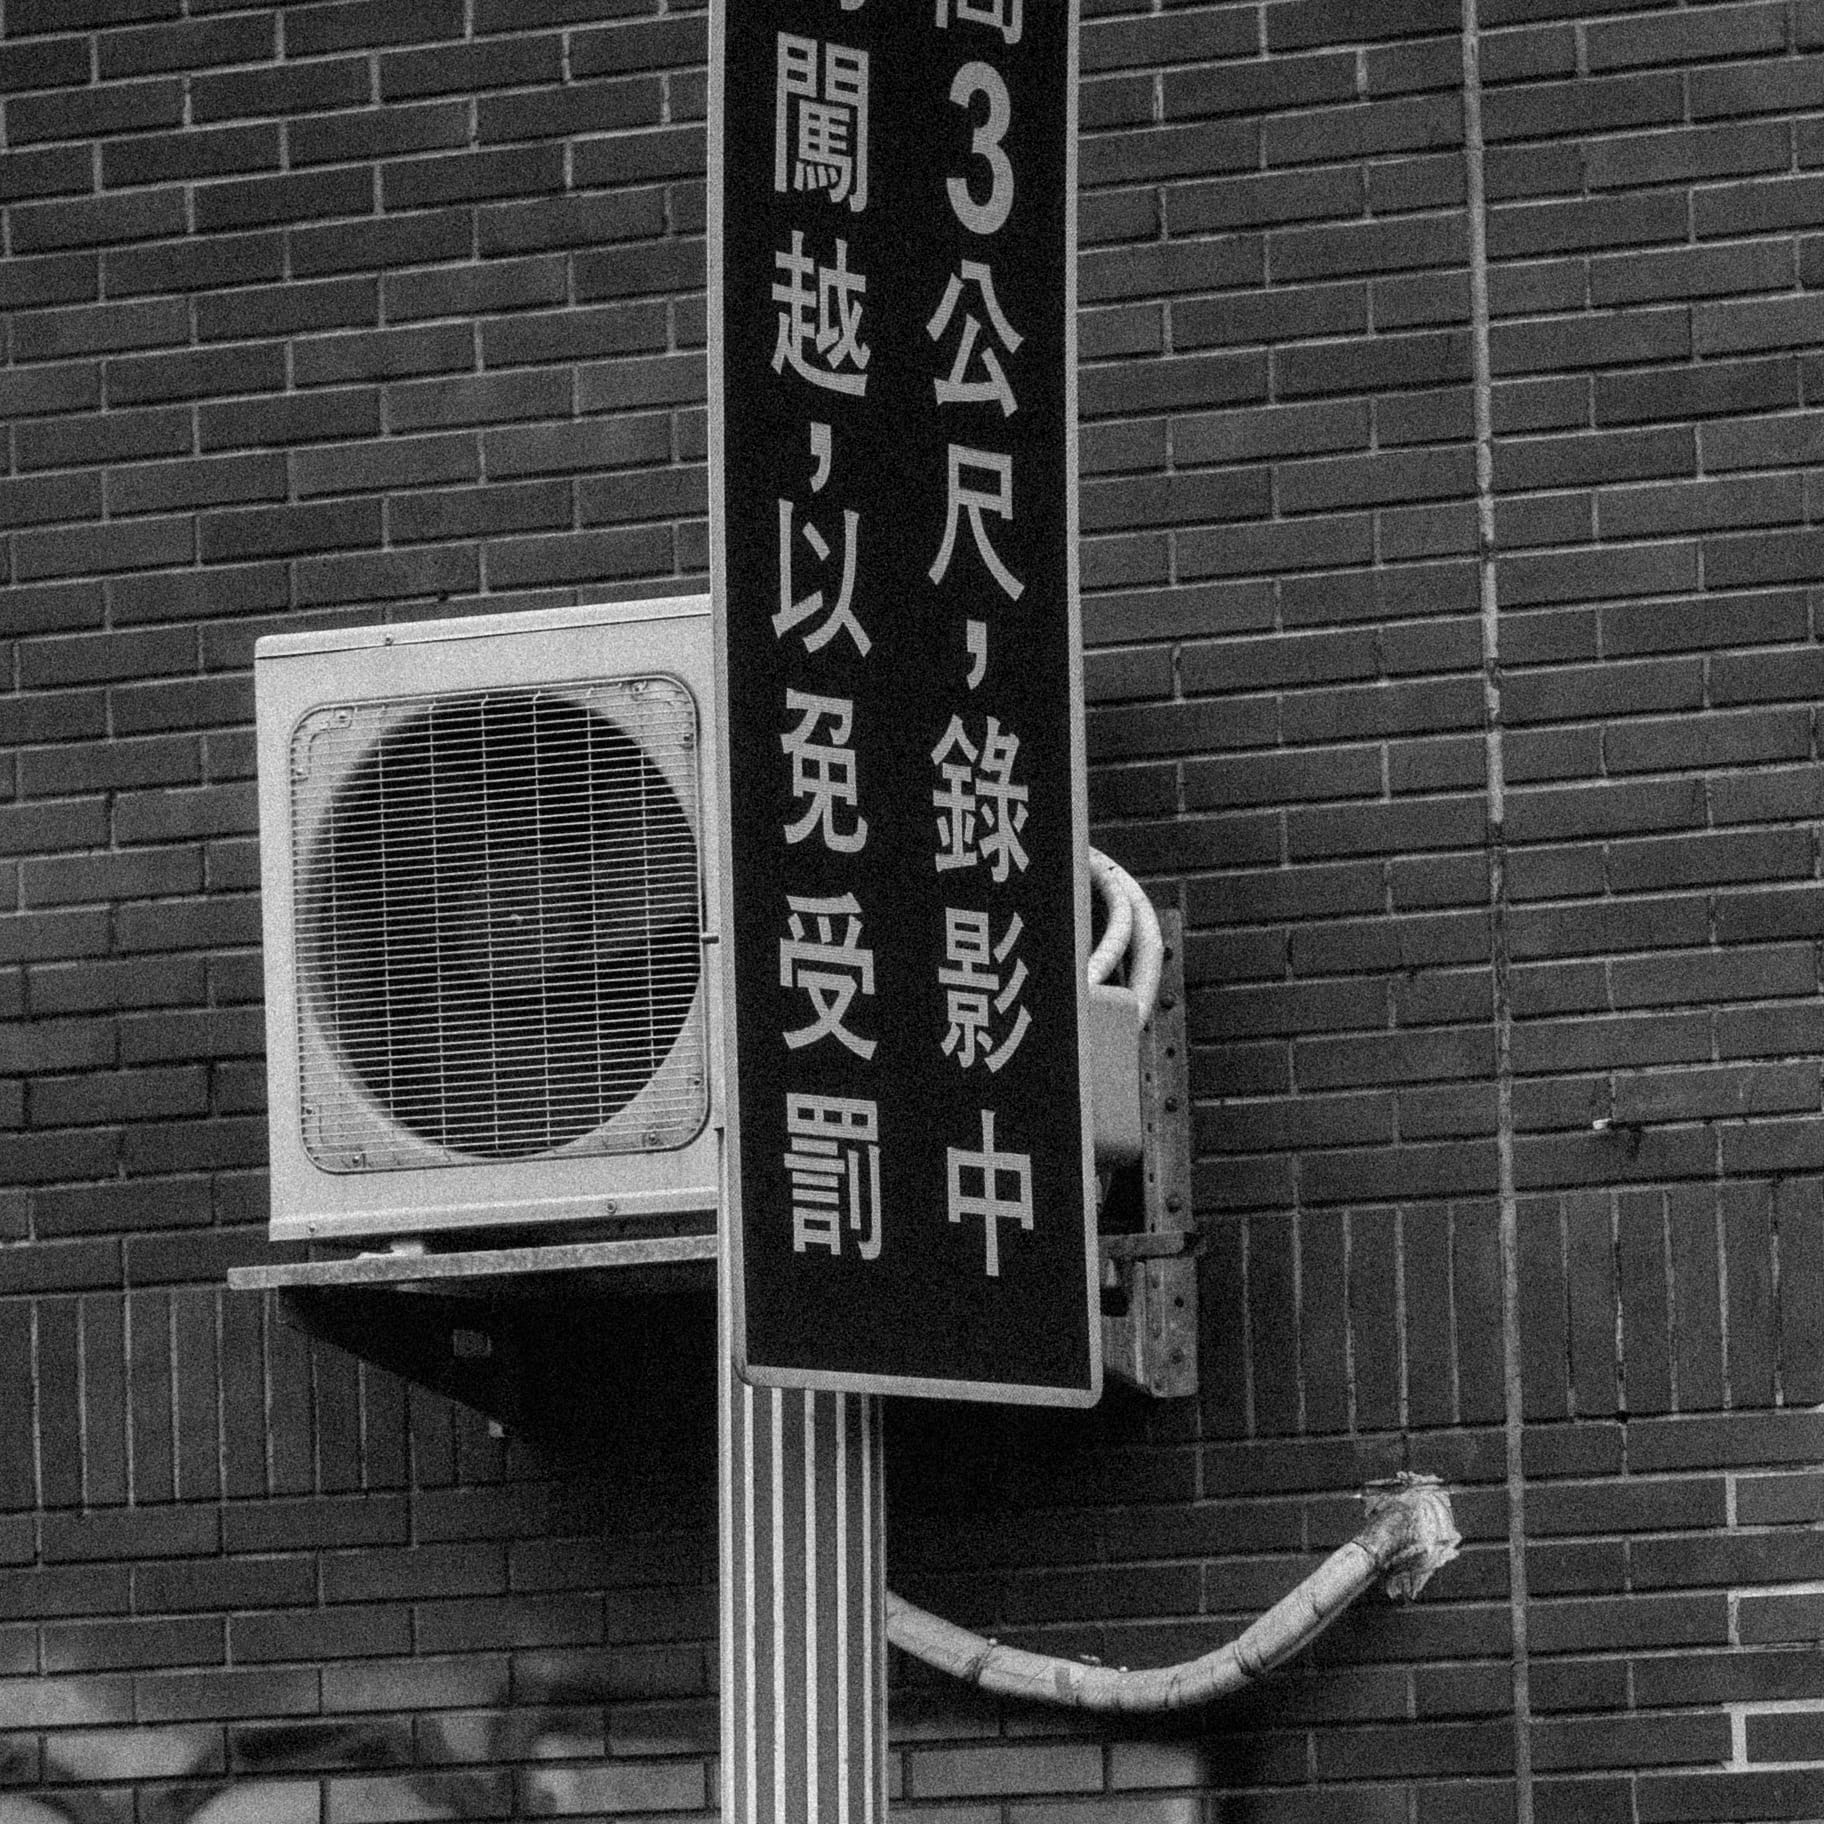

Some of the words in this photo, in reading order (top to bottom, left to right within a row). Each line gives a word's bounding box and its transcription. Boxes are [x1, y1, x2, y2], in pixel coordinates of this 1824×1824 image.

[770, 0, 883, 1261] 闖越，以免受罰
[926, 0, 1034, 1277] 3公尺，錄影中
